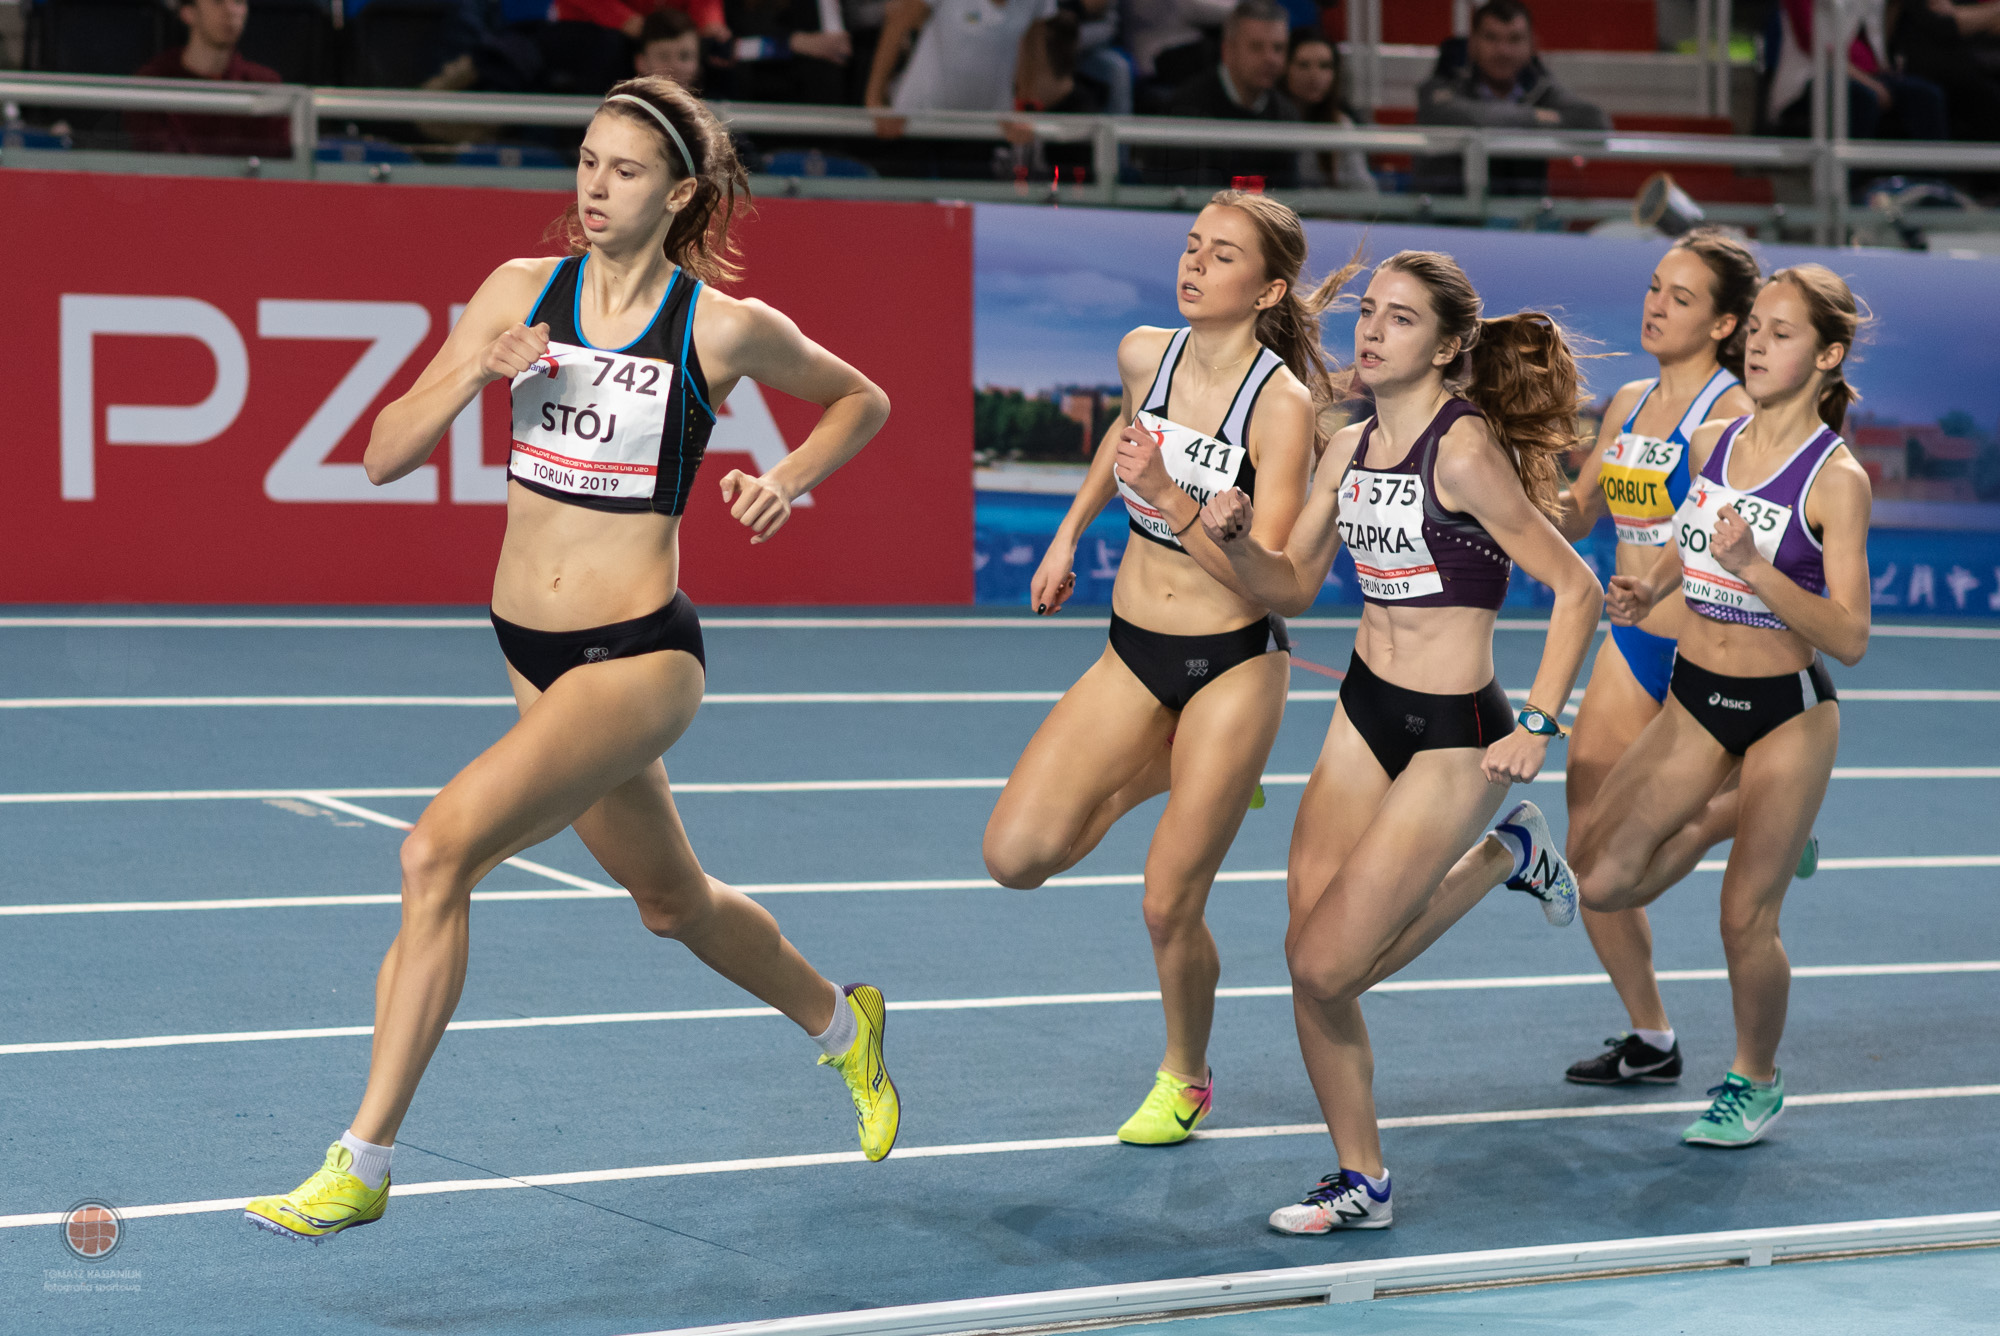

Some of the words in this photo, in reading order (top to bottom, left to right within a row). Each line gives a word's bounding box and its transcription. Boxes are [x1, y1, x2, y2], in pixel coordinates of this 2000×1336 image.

[592, 356, 661, 396] 742
[541, 401, 617, 443] STÓJ
[1184, 438, 1232, 474] 411
[1637, 442, 1674, 465] 765
[533, 462, 575, 487] TORUŃ
[579, 476, 619, 492] 2019
[1369, 478, 1417, 506] 575
[1381, 581, 1410, 595] 2019
[1714, 588, 1743, 606] 2019
[1721, 697, 1752, 711] asics
